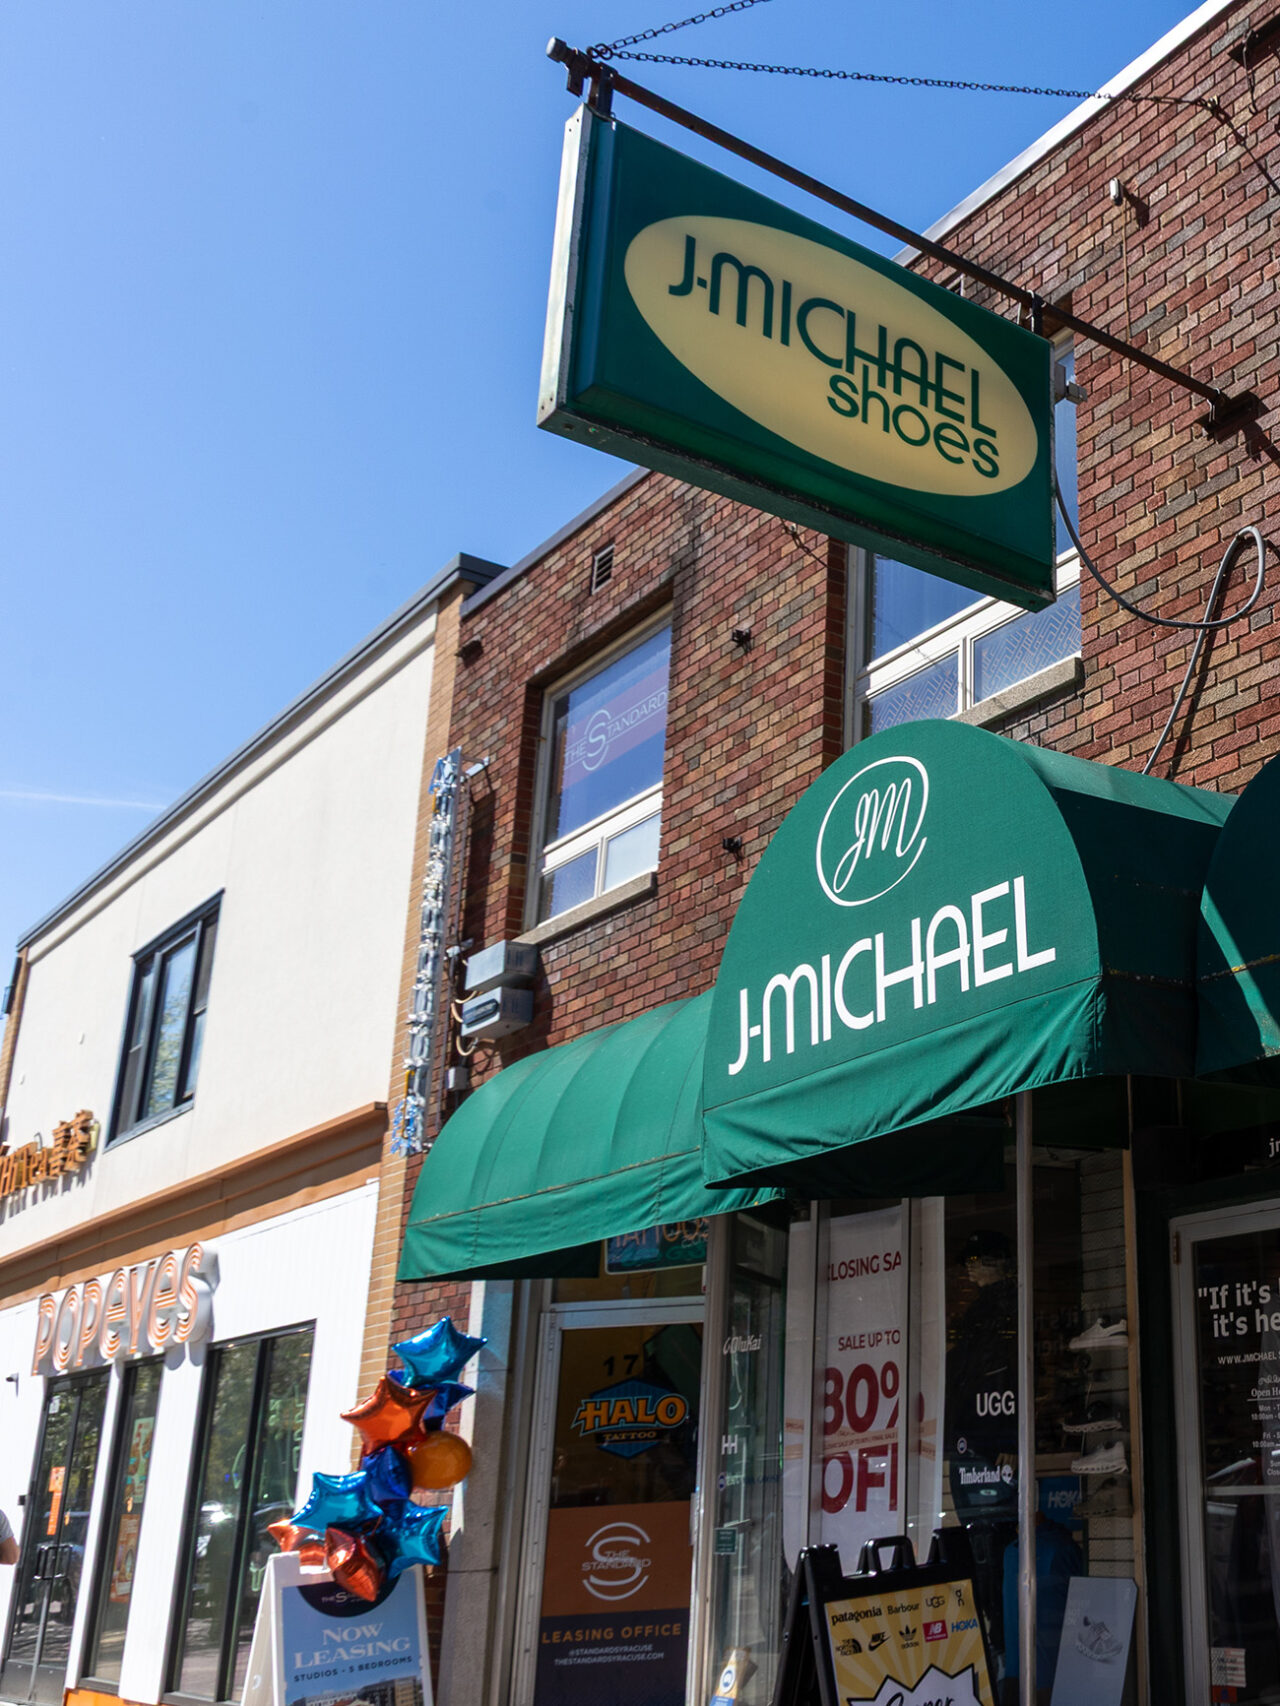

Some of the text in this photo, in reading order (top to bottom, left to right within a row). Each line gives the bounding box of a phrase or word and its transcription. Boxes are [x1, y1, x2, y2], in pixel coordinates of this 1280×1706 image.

[565, 691, 668, 764] THE STANDARD
[1197, 1284, 1230, 1310] "If
[1235, 1280, 1271, 1307] it's
[1213, 1311, 1249, 1338] it's
[838, 1329, 901, 1351] SALE UP TO
[975, 1390, 1016, 1417] UGG
[1251, 1387, 1271, 1399] Open
[572, 1393, 689, 1436] HALO
[1259, 1404, 1271, 1412] Mon
[602, 1430, 658, 1442] TATTOO
[959, 1466, 1001, 1485] Timberland
[831, 1607, 882, 1625] patagonia
[887, 1603, 920, 1615] Barbour
[925, 1595, 946, 1608] UGG
[322, 1622, 384, 1646] NOW
[541, 1623, 682, 1645] LEASING OFFICE
[951, 1618, 978, 1632] HOKA
[294, 1637, 411, 1669] LEASING
[568, 1643, 654, 1657] @STANDARDSYRACUSE
[294, 1668, 339, 1683] STUDIOS
[357, 1655, 413, 1672] BEDROOMS
